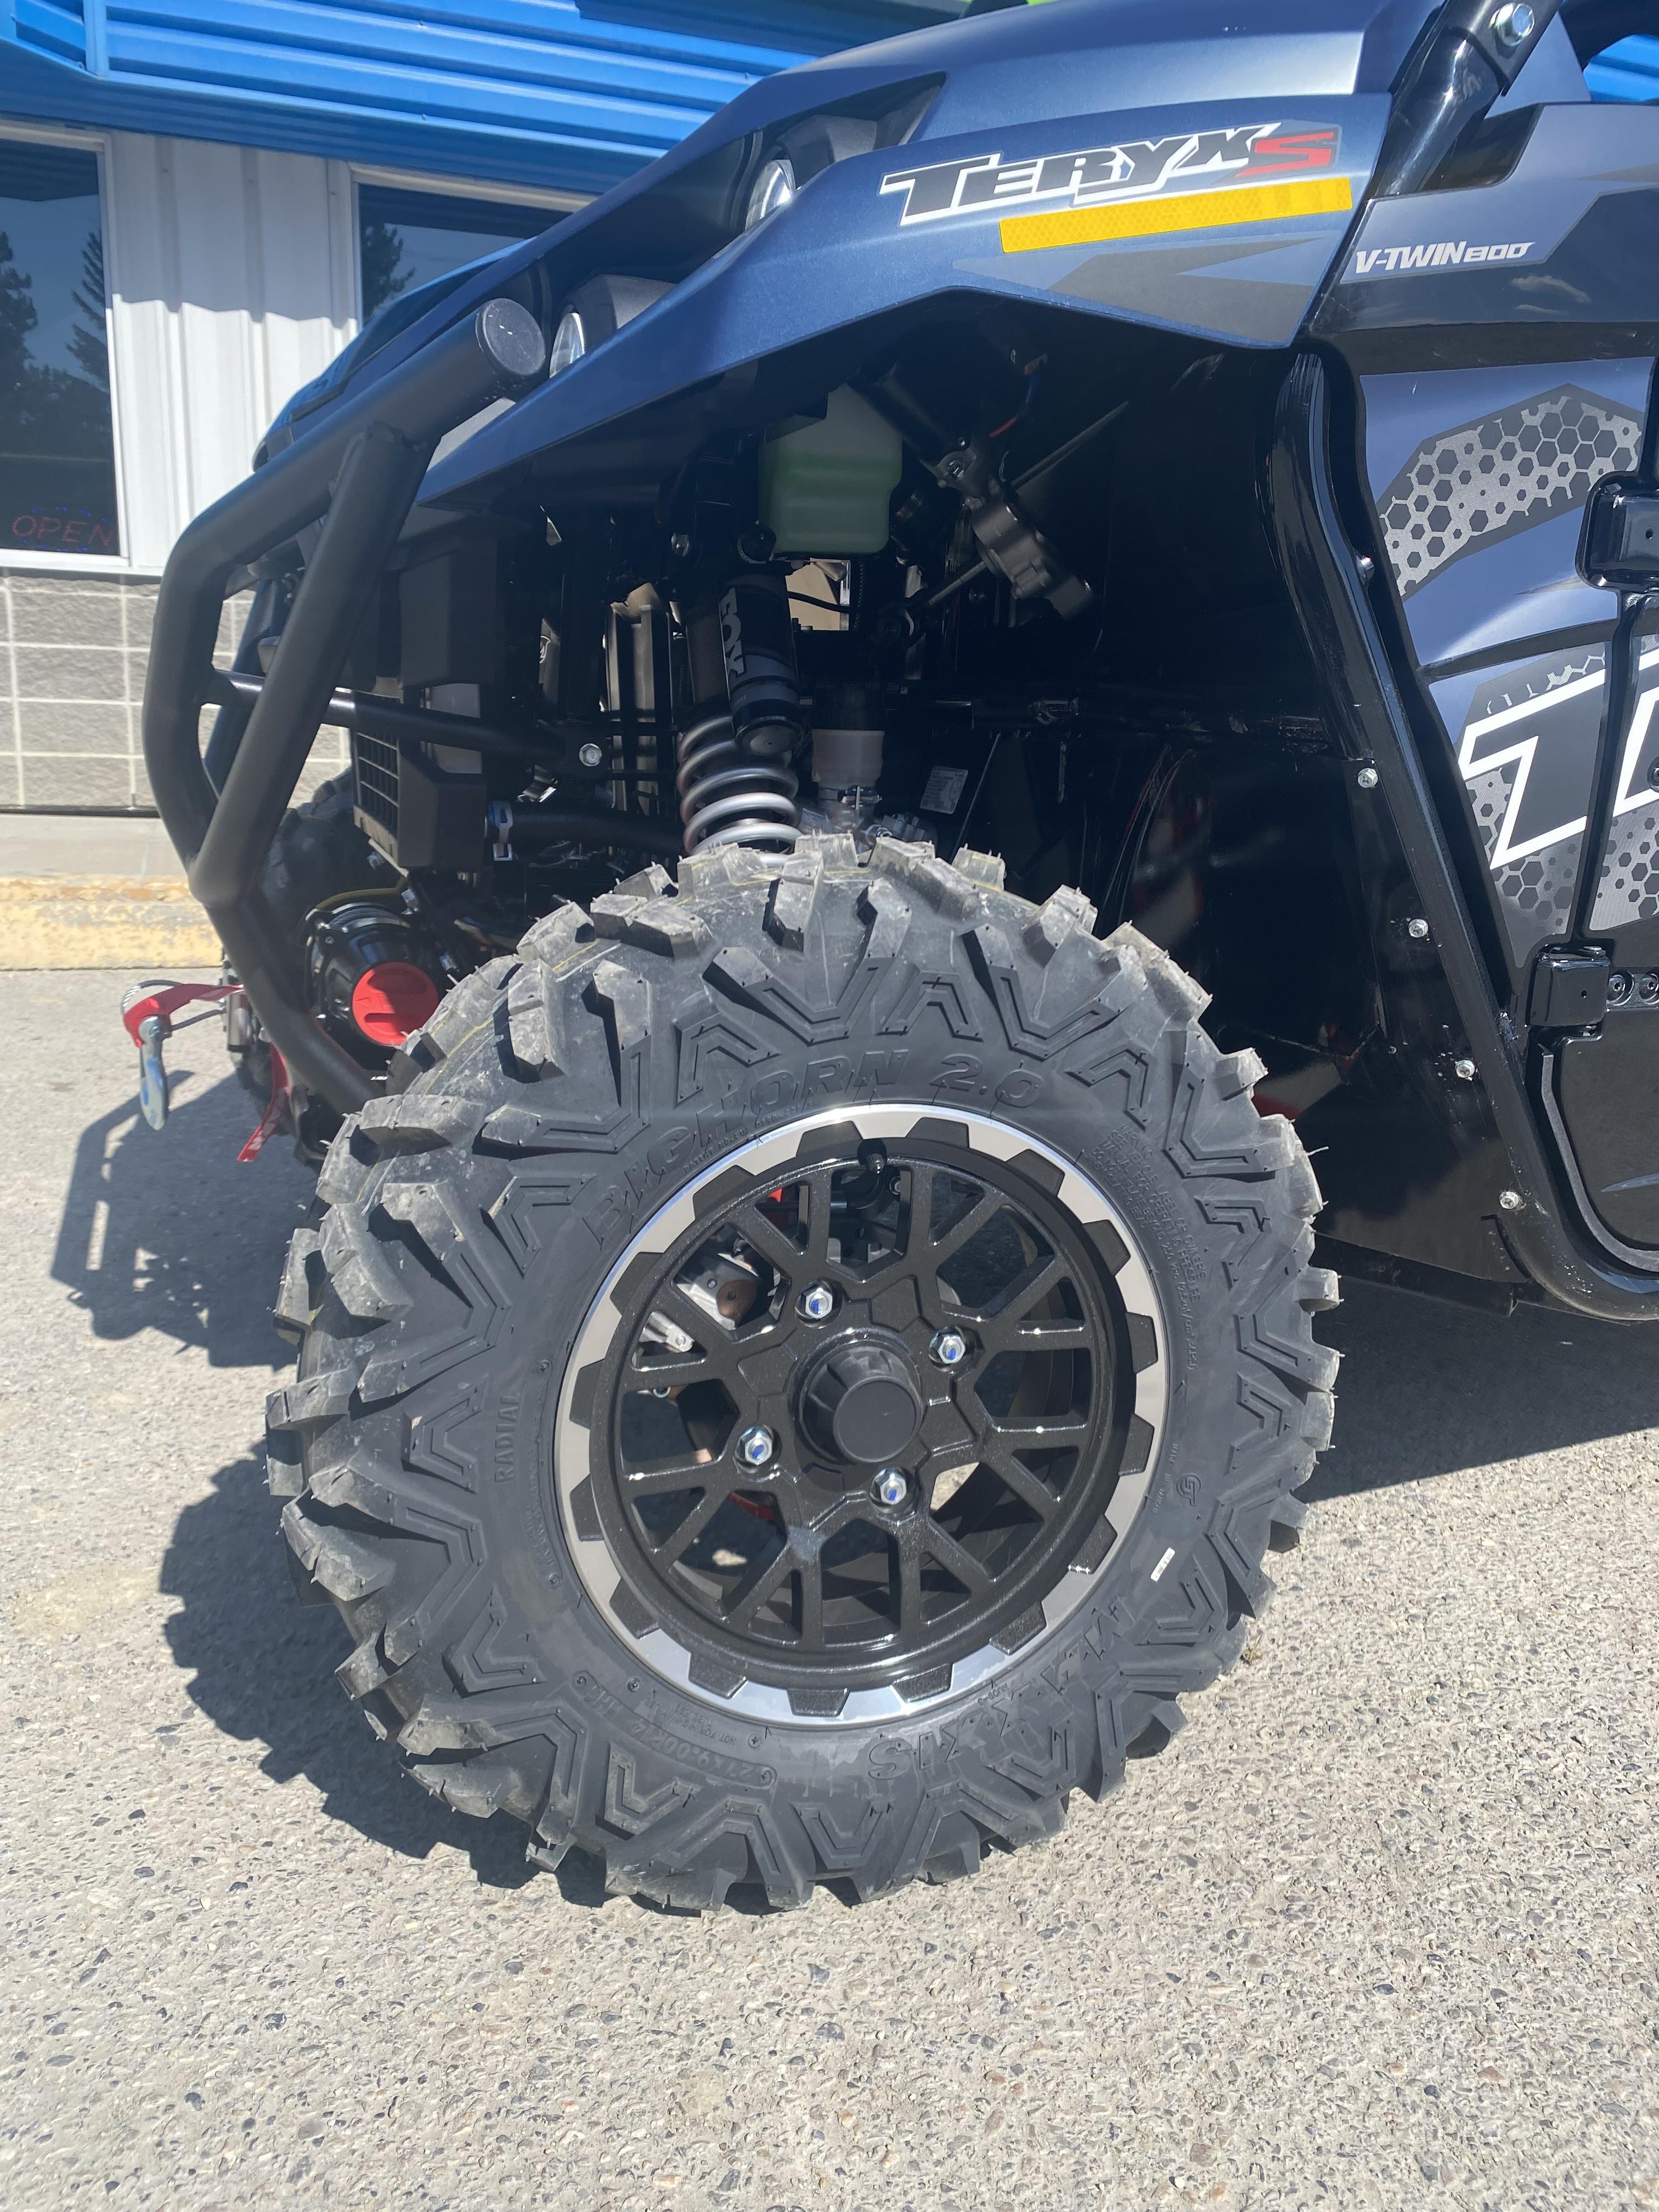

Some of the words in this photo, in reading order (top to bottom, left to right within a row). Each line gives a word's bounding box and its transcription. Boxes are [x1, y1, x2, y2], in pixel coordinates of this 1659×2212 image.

[12, 515, 116, 546] OPEN
[581, 1049, 907, 1239] BIGHORN
[938, 1052, 1046, 1109] 2.0
[494, 1391, 520, 1483] RADIAL
[867, 1598, 1135, 1781] MAXXIS
